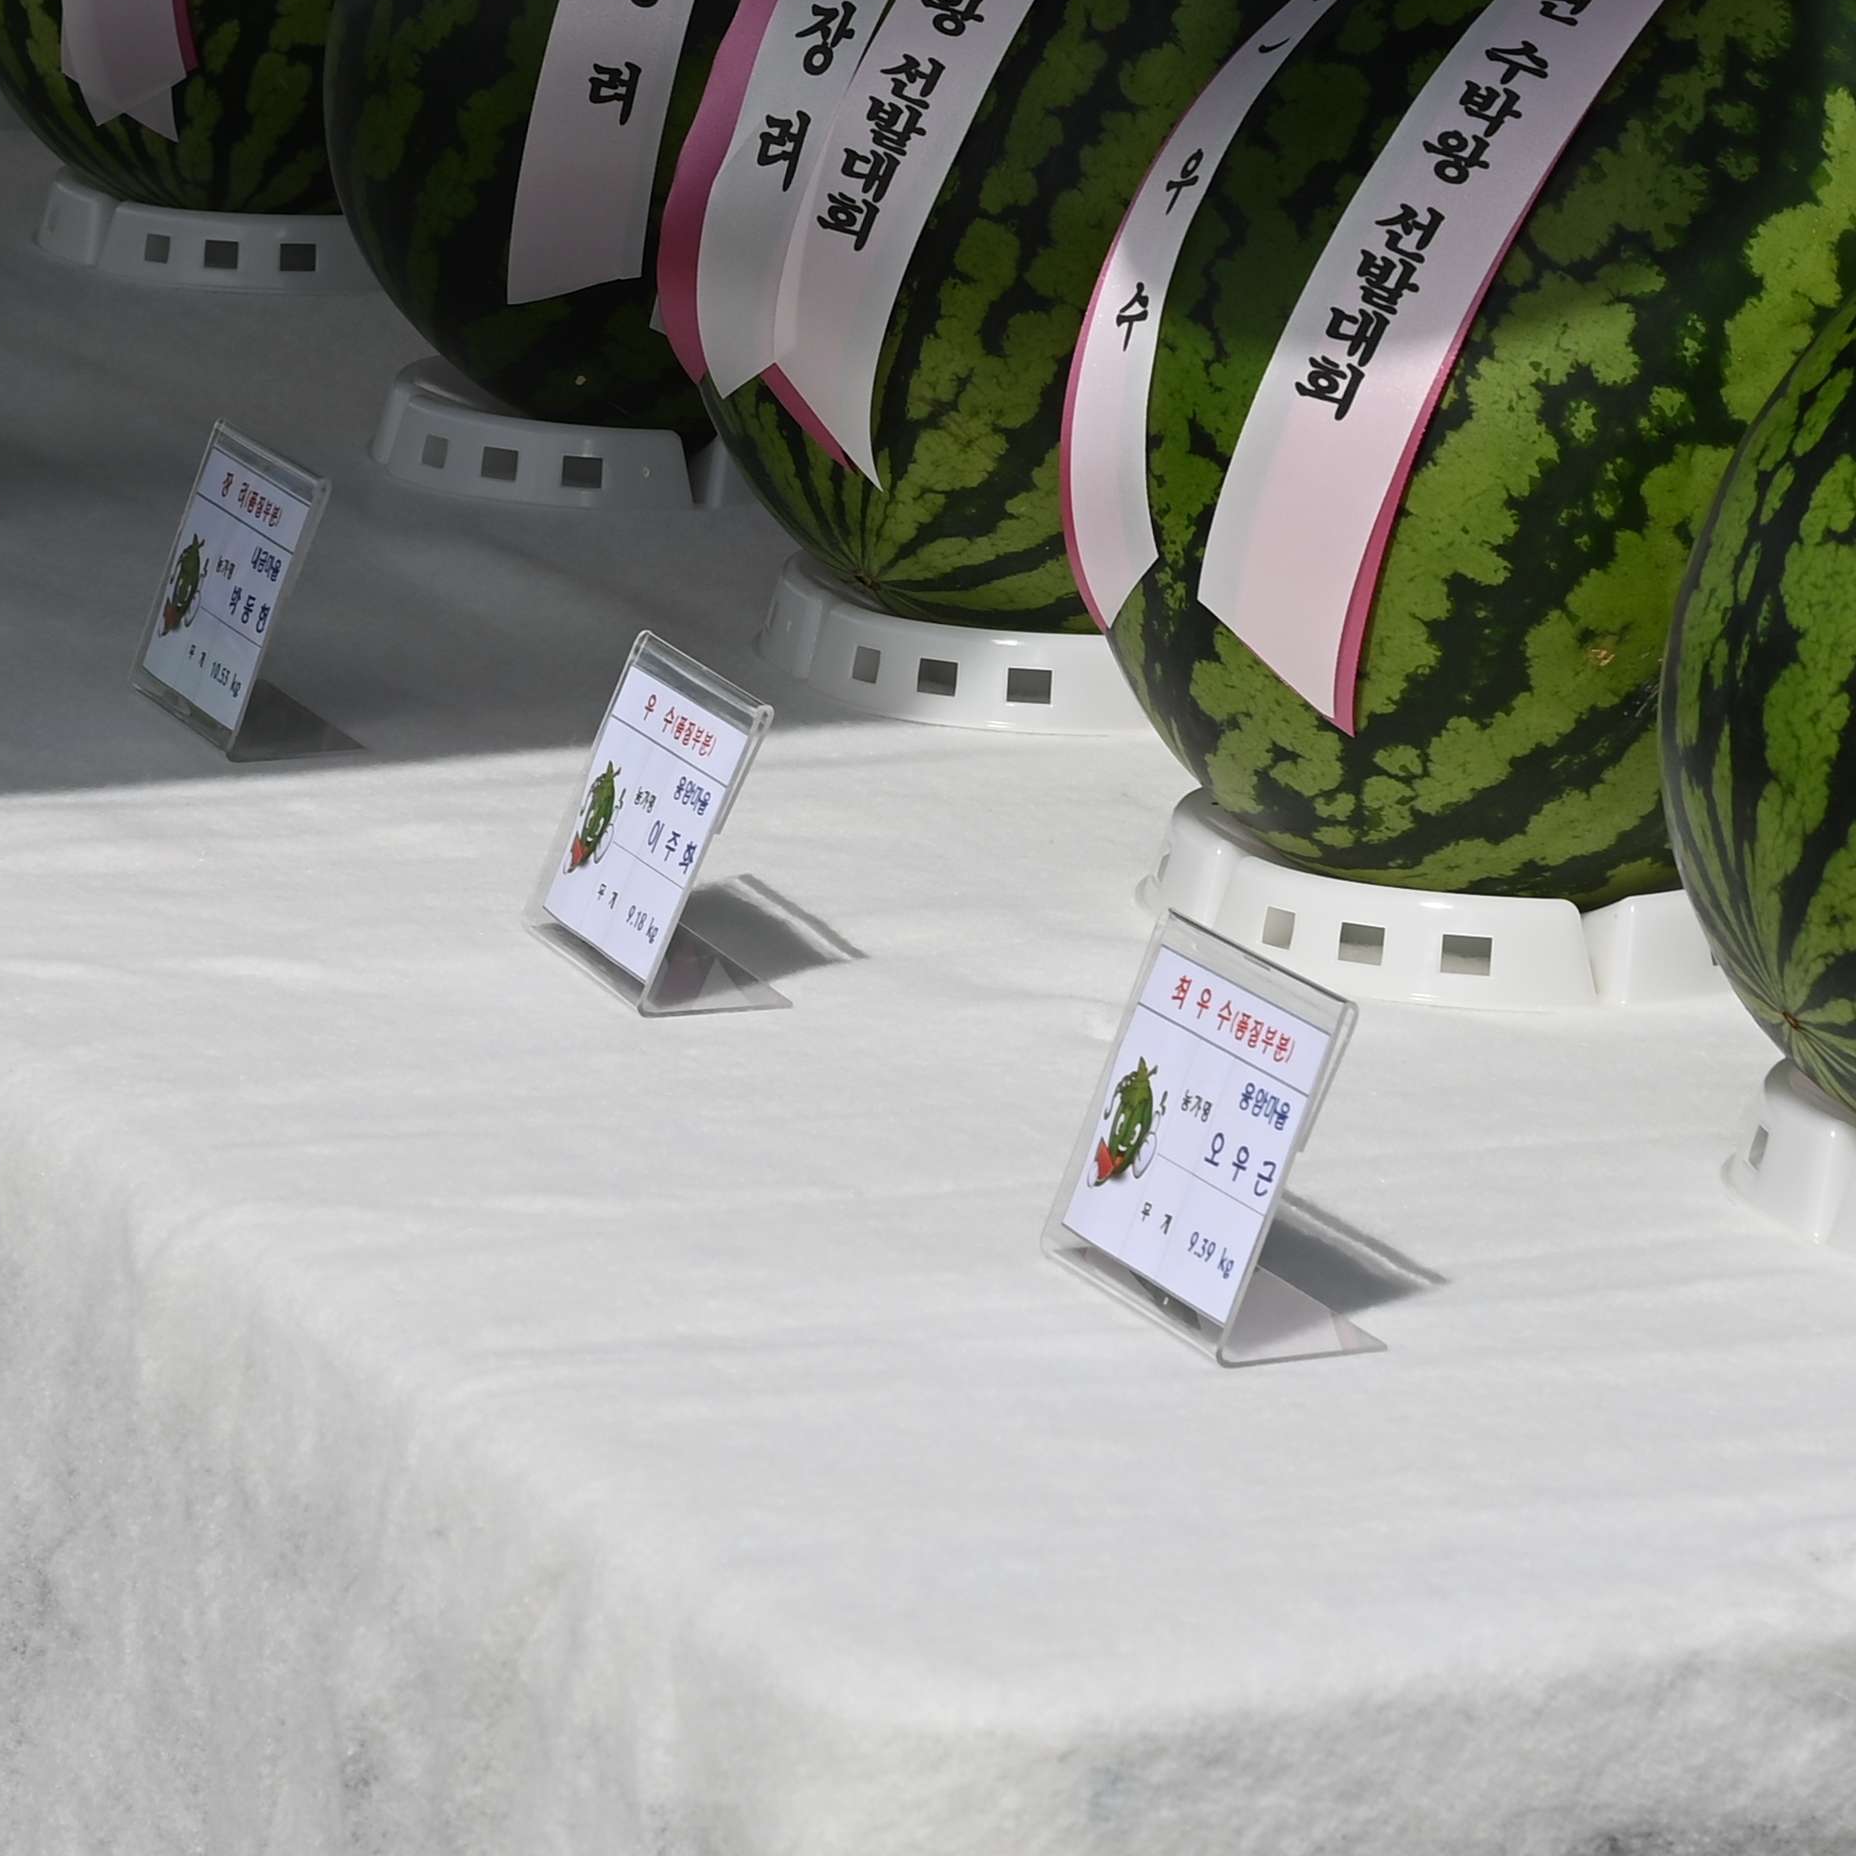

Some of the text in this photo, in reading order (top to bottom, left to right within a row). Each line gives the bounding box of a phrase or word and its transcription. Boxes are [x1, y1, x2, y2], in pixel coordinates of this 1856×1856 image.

[758, 0, 858, 193] 장려
[815, 51, 949, 252] 선발대회
[1420, 38, 1552, 186] 수박왕
[1115, 147, 1205, 352] 우수
[1294, 201, 1448, 422] 선발대회
[645, 917, 659, 945] kg
[1180, 1089, 1213, 1123] 농가명
[1203, 1132, 1277, 1198] 오우근
[1141, 1201, 1235, 1280] 무게 9.39 kg
